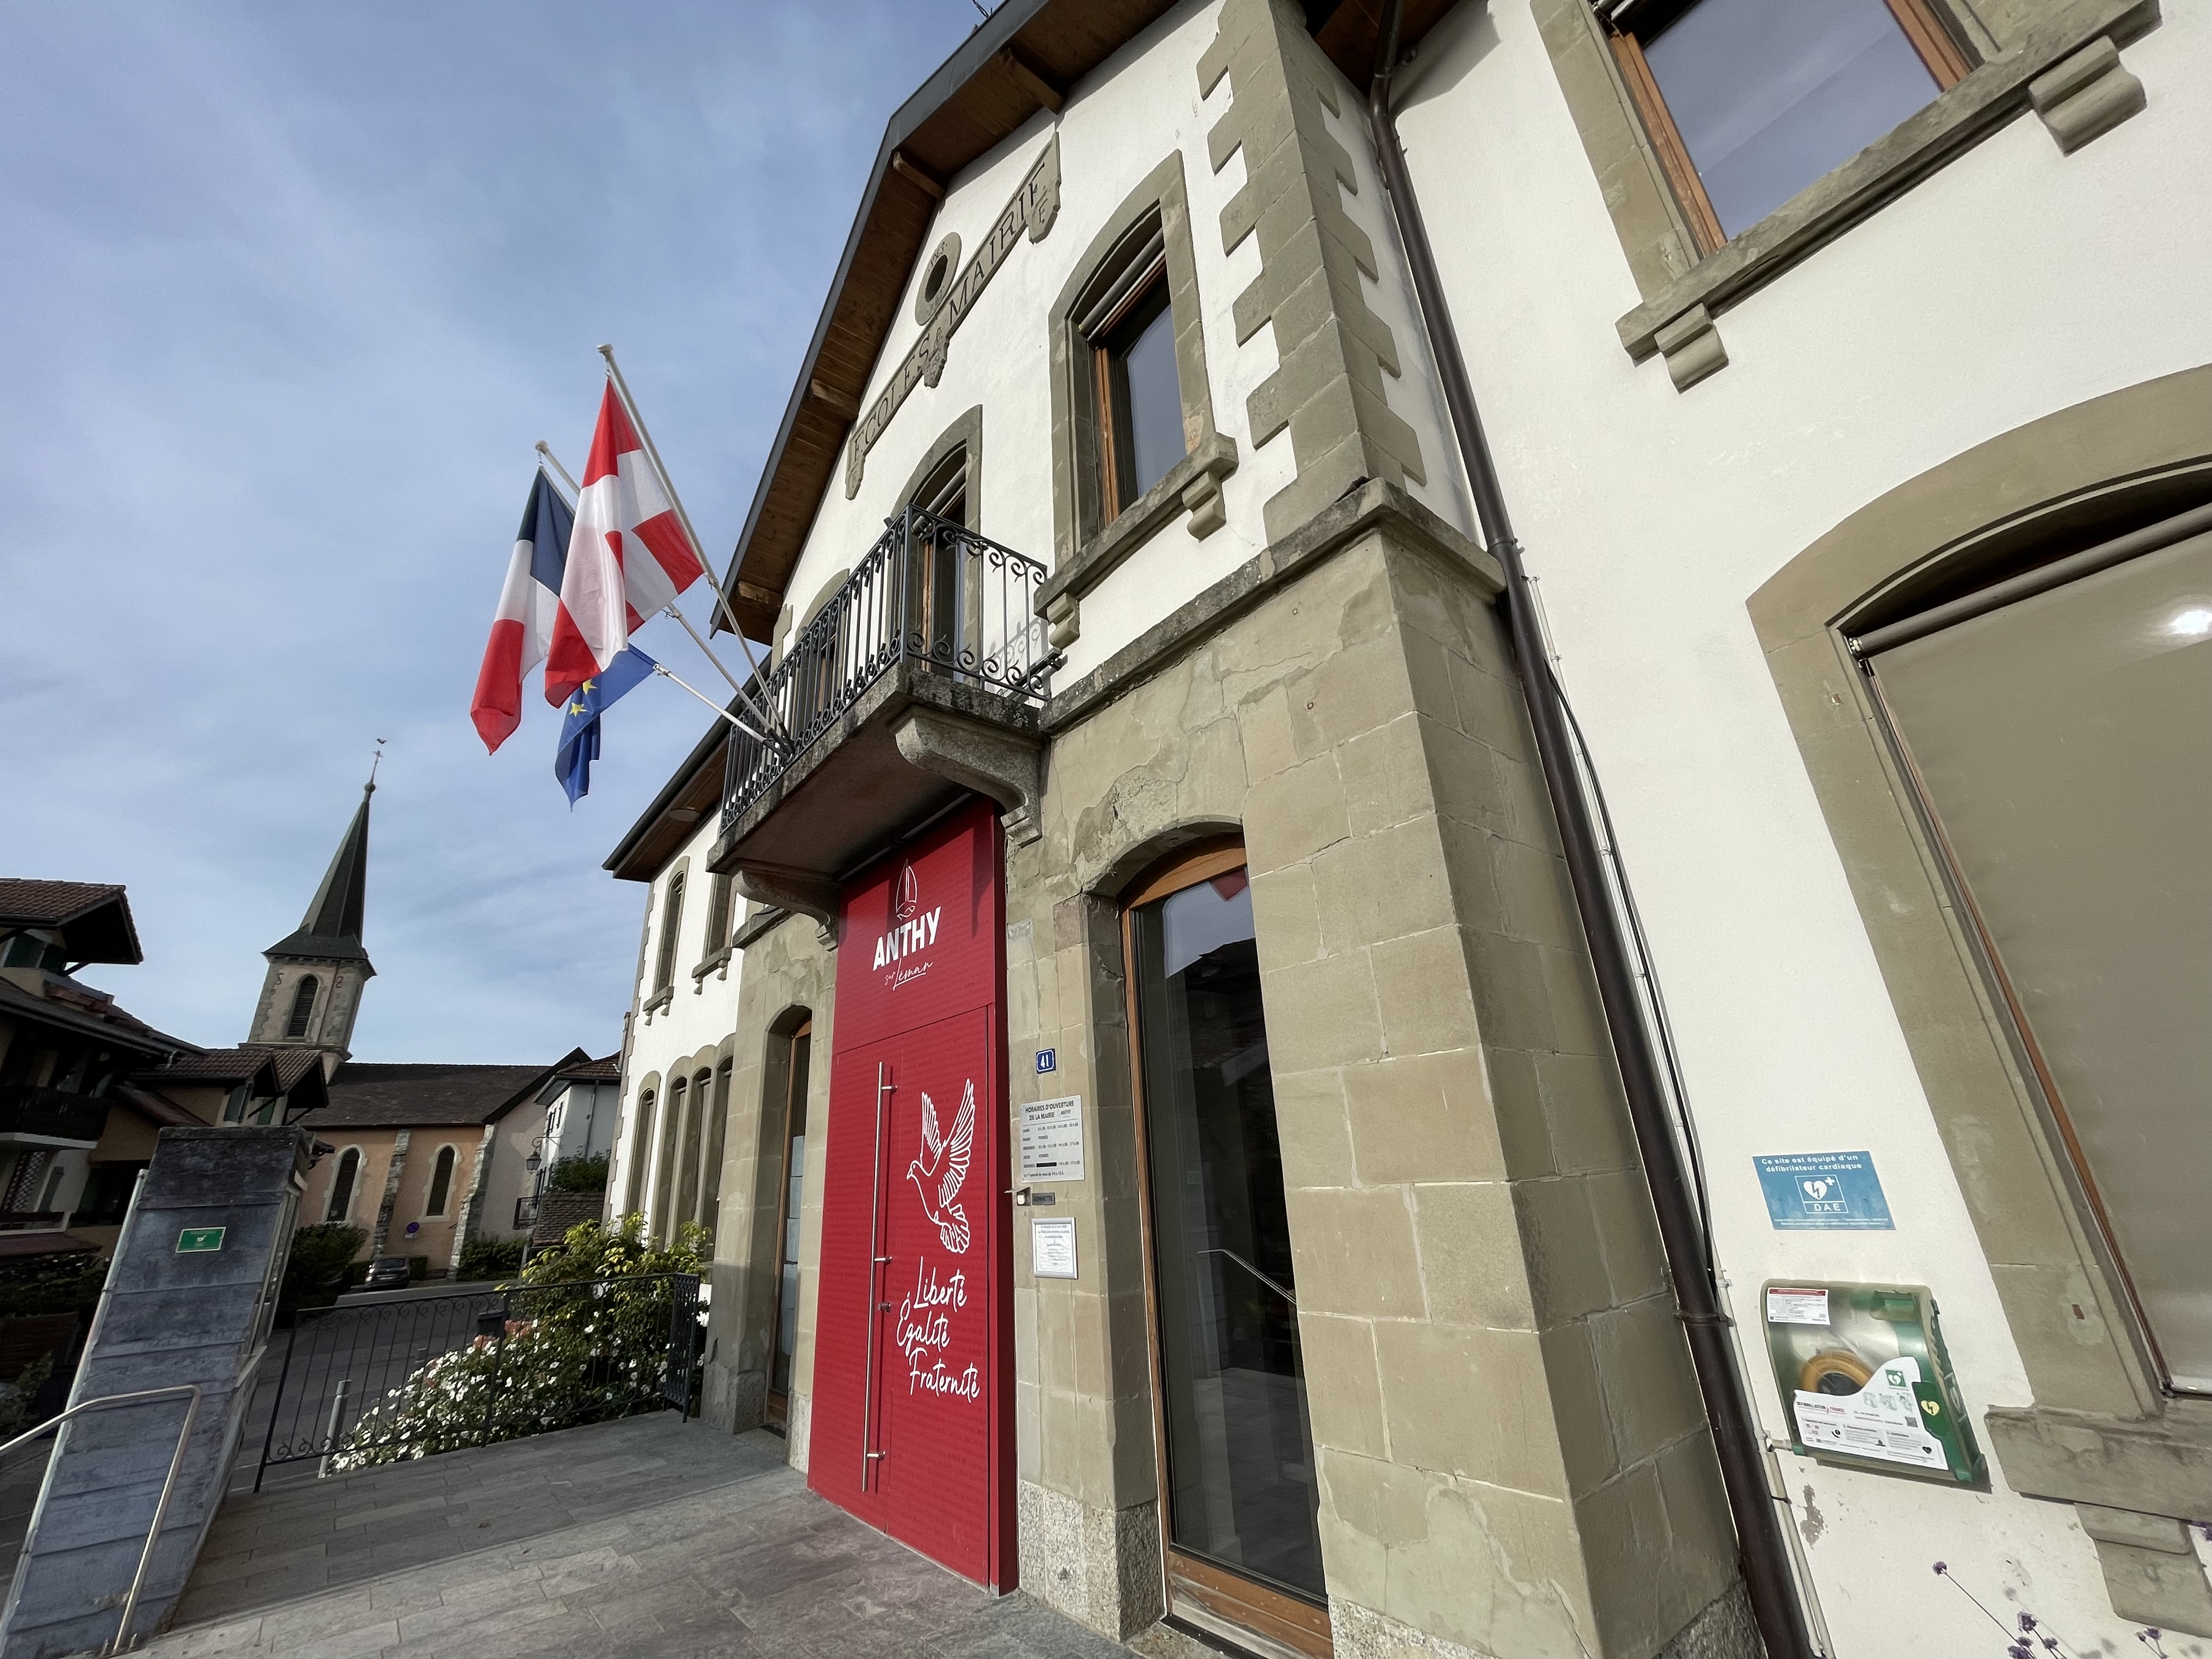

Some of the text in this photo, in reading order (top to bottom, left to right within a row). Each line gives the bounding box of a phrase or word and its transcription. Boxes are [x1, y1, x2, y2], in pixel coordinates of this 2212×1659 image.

[854, 332, 930, 462] ECOLES
[949, 162, 1045, 325] MAIRIE
[872, 906, 941, 971] ANTHY
[884, 971, 896, 986] sur
[1040, 1054, 1049, 1068] 41
[1025, 1101, 1074, 1113] HORAIRES D'OUVERTURE
[1807, 1155, 1836, 1164] équipé
[913, 1255, 967, 1313] Liberté
[896, 1291, 950, 1357] Égalité
[909, 1346, 980, 1403] Fraternité
